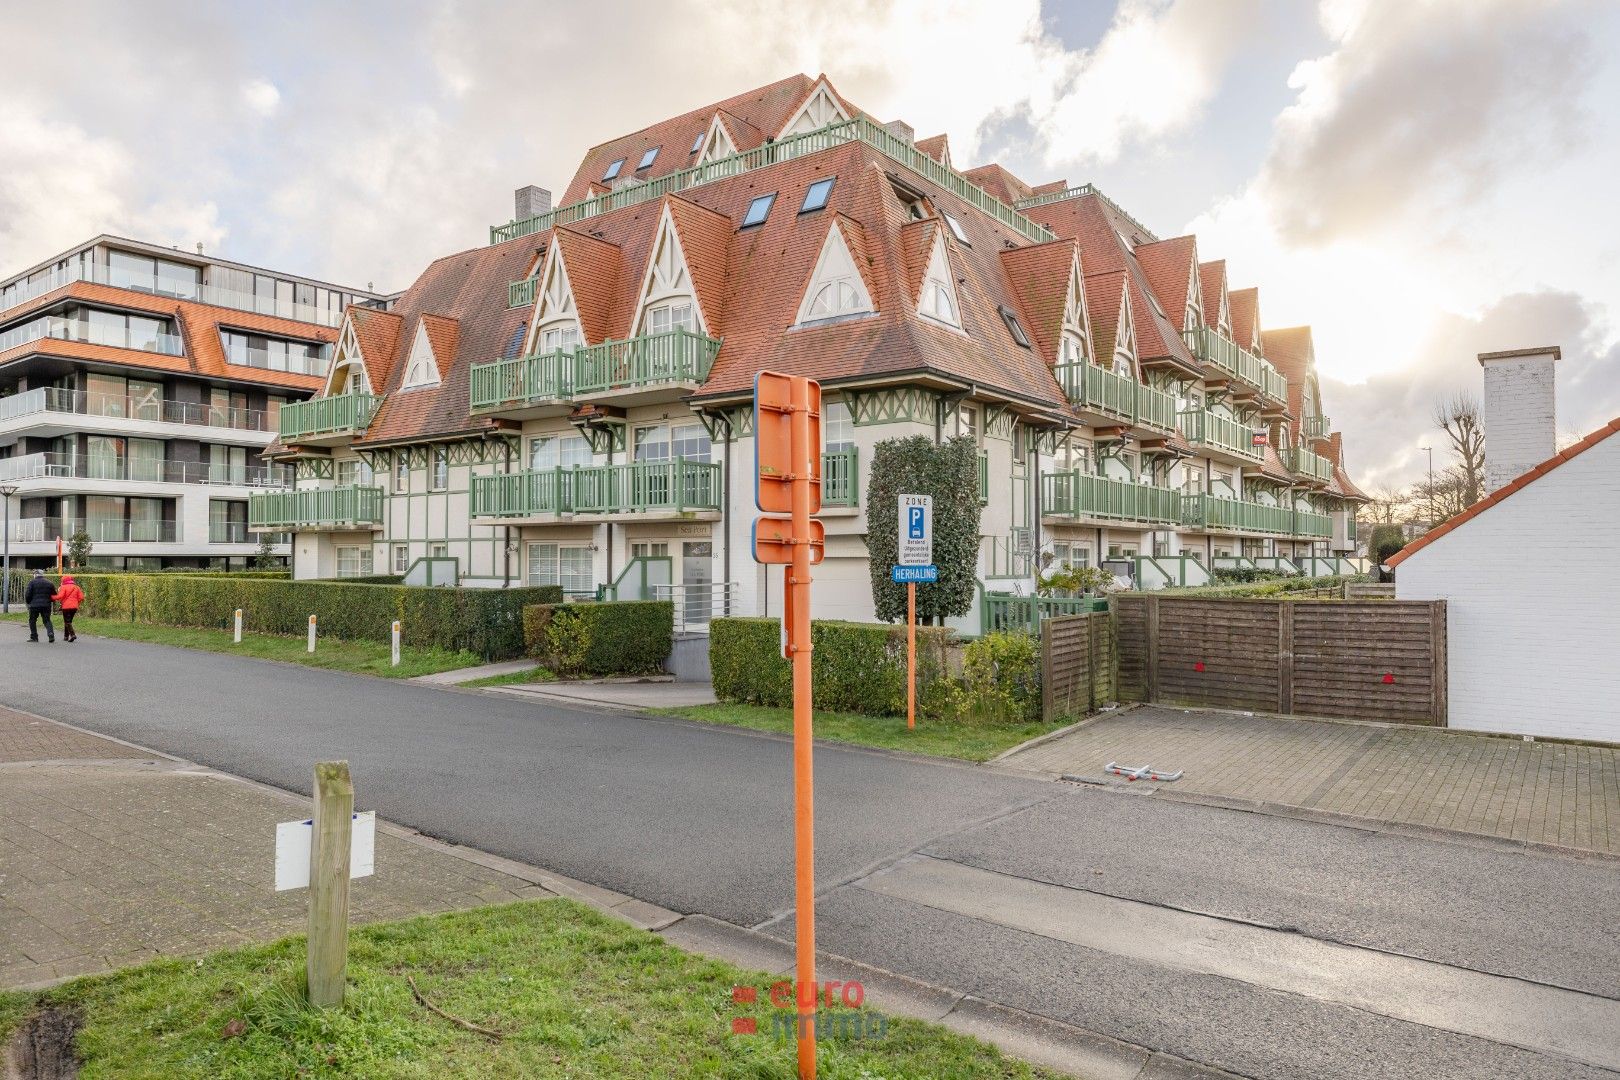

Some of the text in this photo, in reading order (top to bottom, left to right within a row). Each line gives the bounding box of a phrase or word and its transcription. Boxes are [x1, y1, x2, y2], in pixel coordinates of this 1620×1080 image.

[906, 497, 927, 506] ZONE
[912, 509, 920, 526] P
[895, 568, 937, 579] HERHALING
